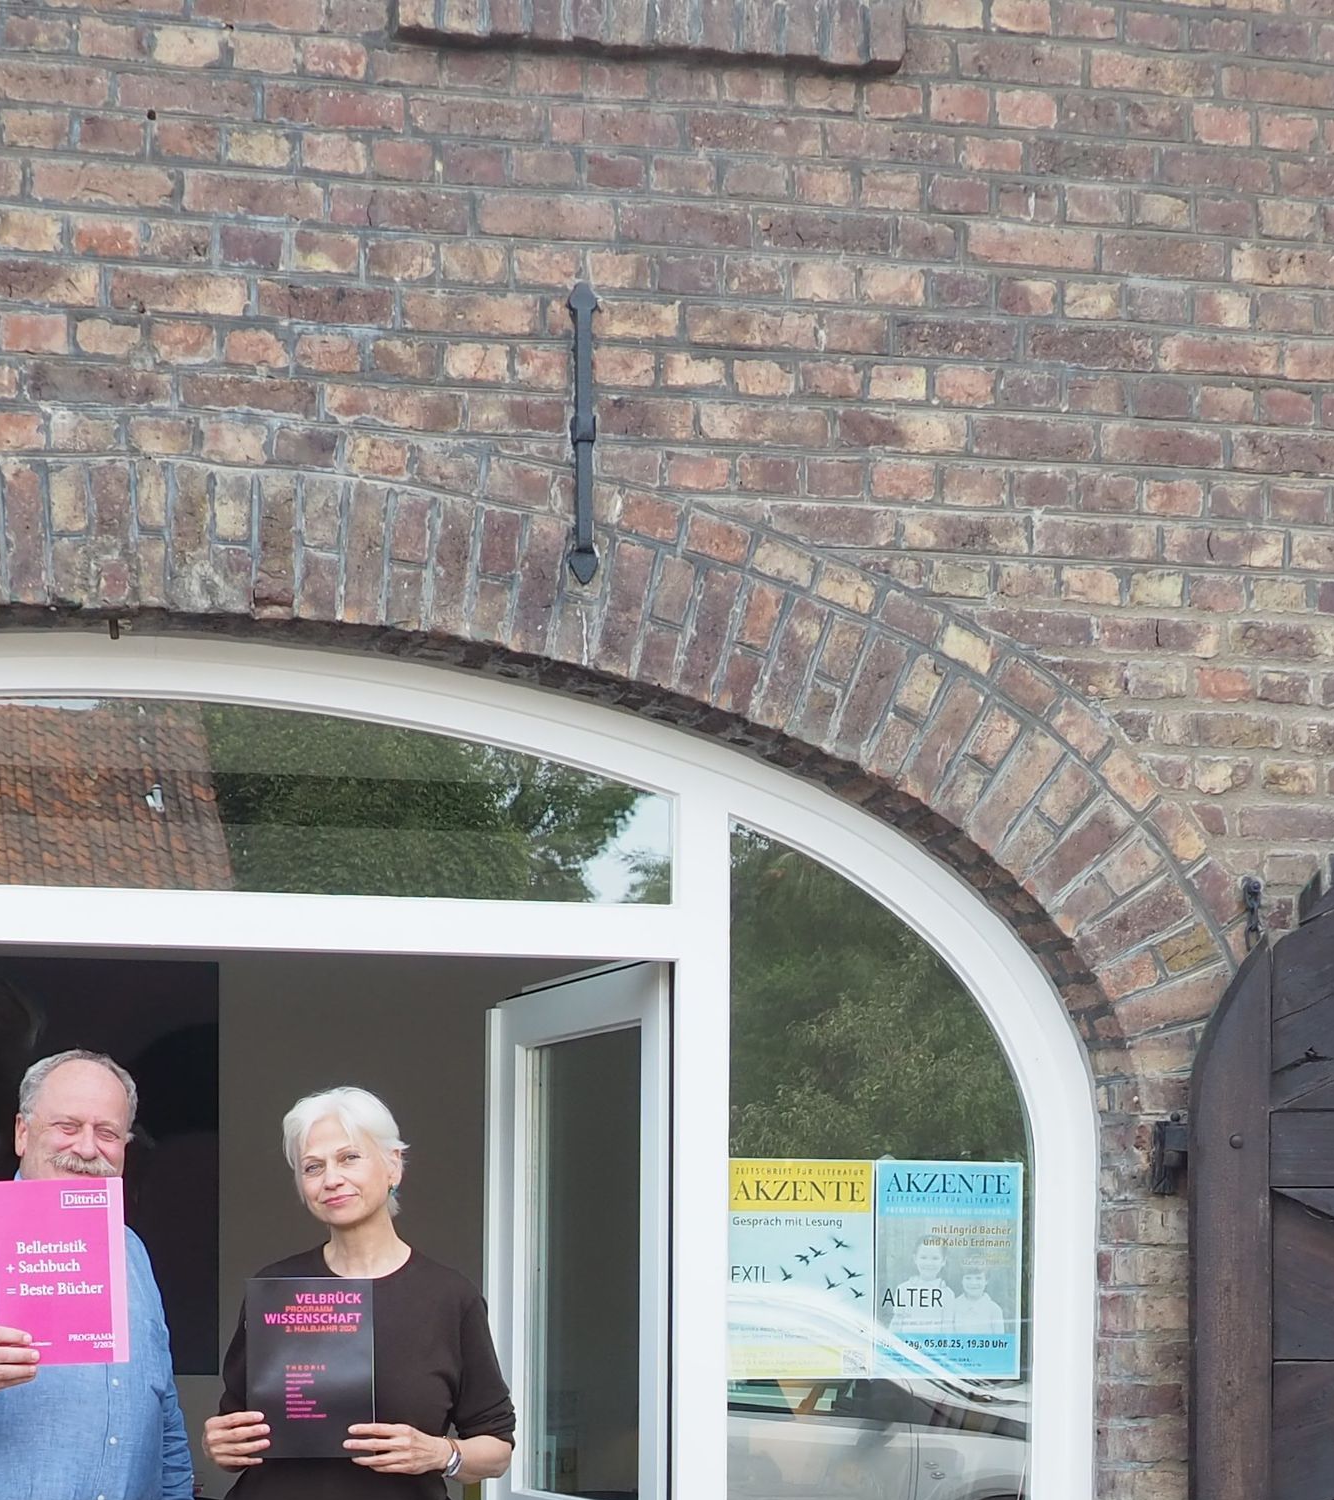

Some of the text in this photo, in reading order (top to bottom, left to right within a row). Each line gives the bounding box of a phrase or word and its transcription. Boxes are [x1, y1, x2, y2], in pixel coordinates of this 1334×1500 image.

[735, 1166, 865, 1177] ZEITSCHRIFT FÜR LITERATUR
[886, 1172, 1011, 1195] AKZENTE
[732, 1179, 866, 1203] AKZENTE
[64, 1193, 107, 1206] Dittrich
[732, 1216, 843, 1229] Gespräch mit Lesung
[931, 1224, 1011, 1237] mit Ingrid Bacher
[16, 1240, 87, 1255] Belletristik
[923, 1237, 1011, 1247] und Kaleb Erdmann
[6, 1258, 81, 1274] + Sachbuch
[731, 1265, 771, 1284] EXIL
[20, 1283, 54, 1297] Beste
[57, 1282, 104, 1296] Bücher
[295, 1291, 362, 1305] VELBRÜCK
[881, 1287, 943, 1308] ALTER
[285, 1305, 334, 1313] PROGRAMM
[264, 1313, 362, 1325] WISSENSCHAFT
[967, 1339, 990, 1349] 19.30
[991, 1339, 1009, 1349] Uhr
